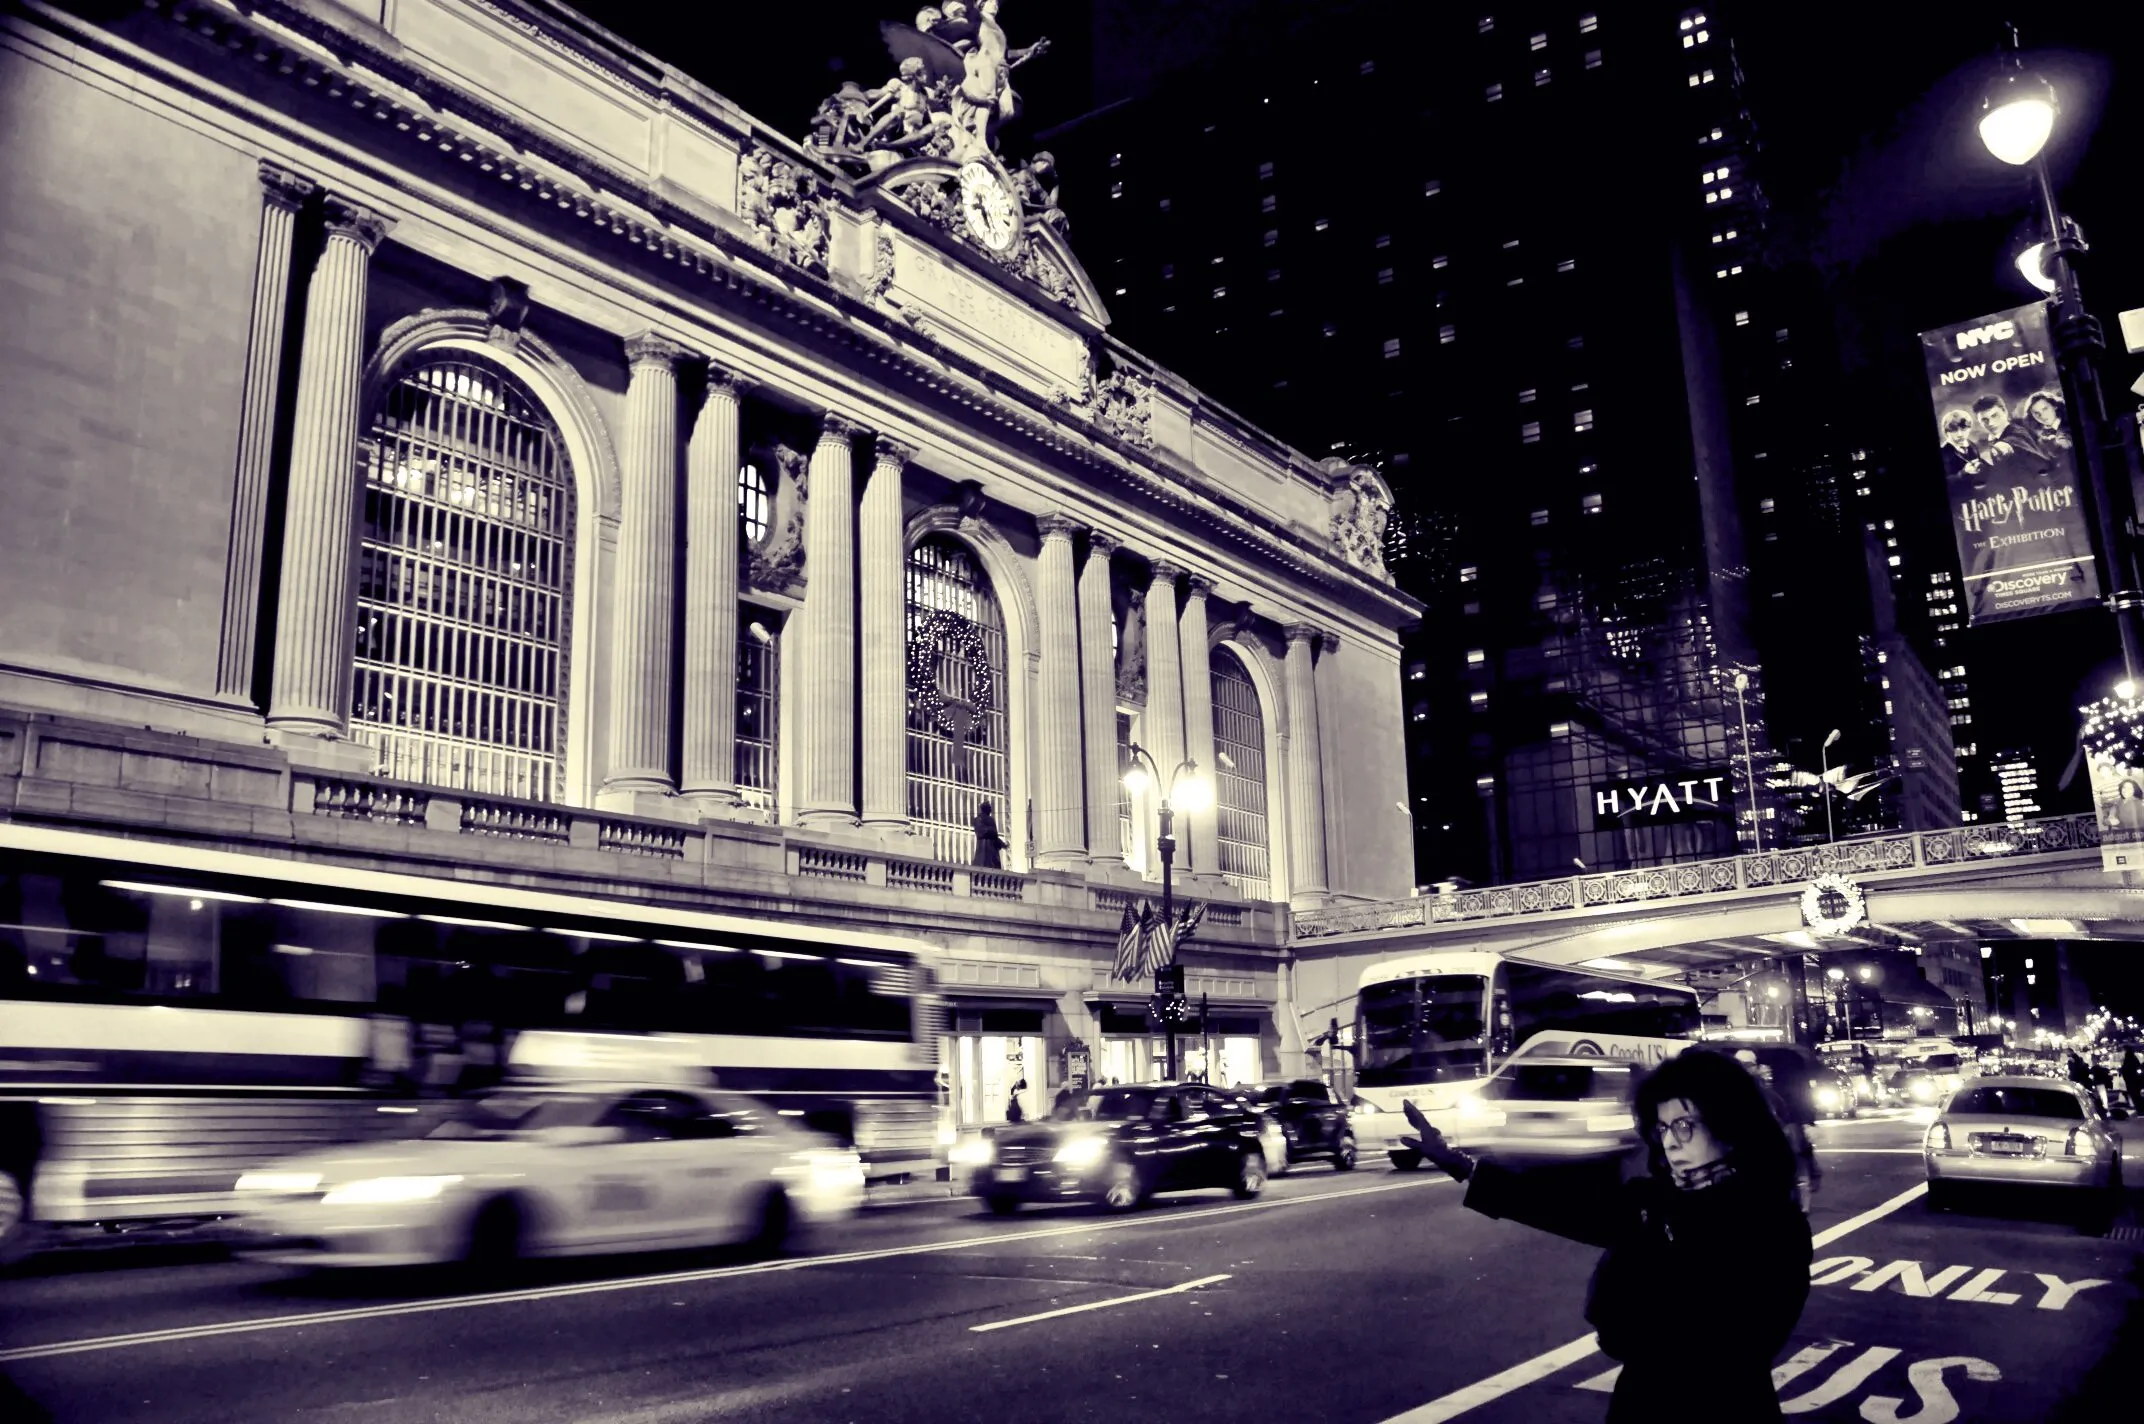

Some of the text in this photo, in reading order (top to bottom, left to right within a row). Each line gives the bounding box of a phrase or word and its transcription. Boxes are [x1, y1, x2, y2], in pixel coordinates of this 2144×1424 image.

[915, 255, 974, 300] GRAND
[1956, 320, 2015, 350] NYC
[1940, 351, 2044, 385] NOW OPEN
[1960, 485, 2073, 532] Harry Potter
[1995, 591, 2072, 610] DISCOVERYTS.COM
[1597, 777, 1723, 815] HYATT
[1610, 1043, 1645, 1061] Coach
[1808, 1256, 2113, 1310] ONLY
